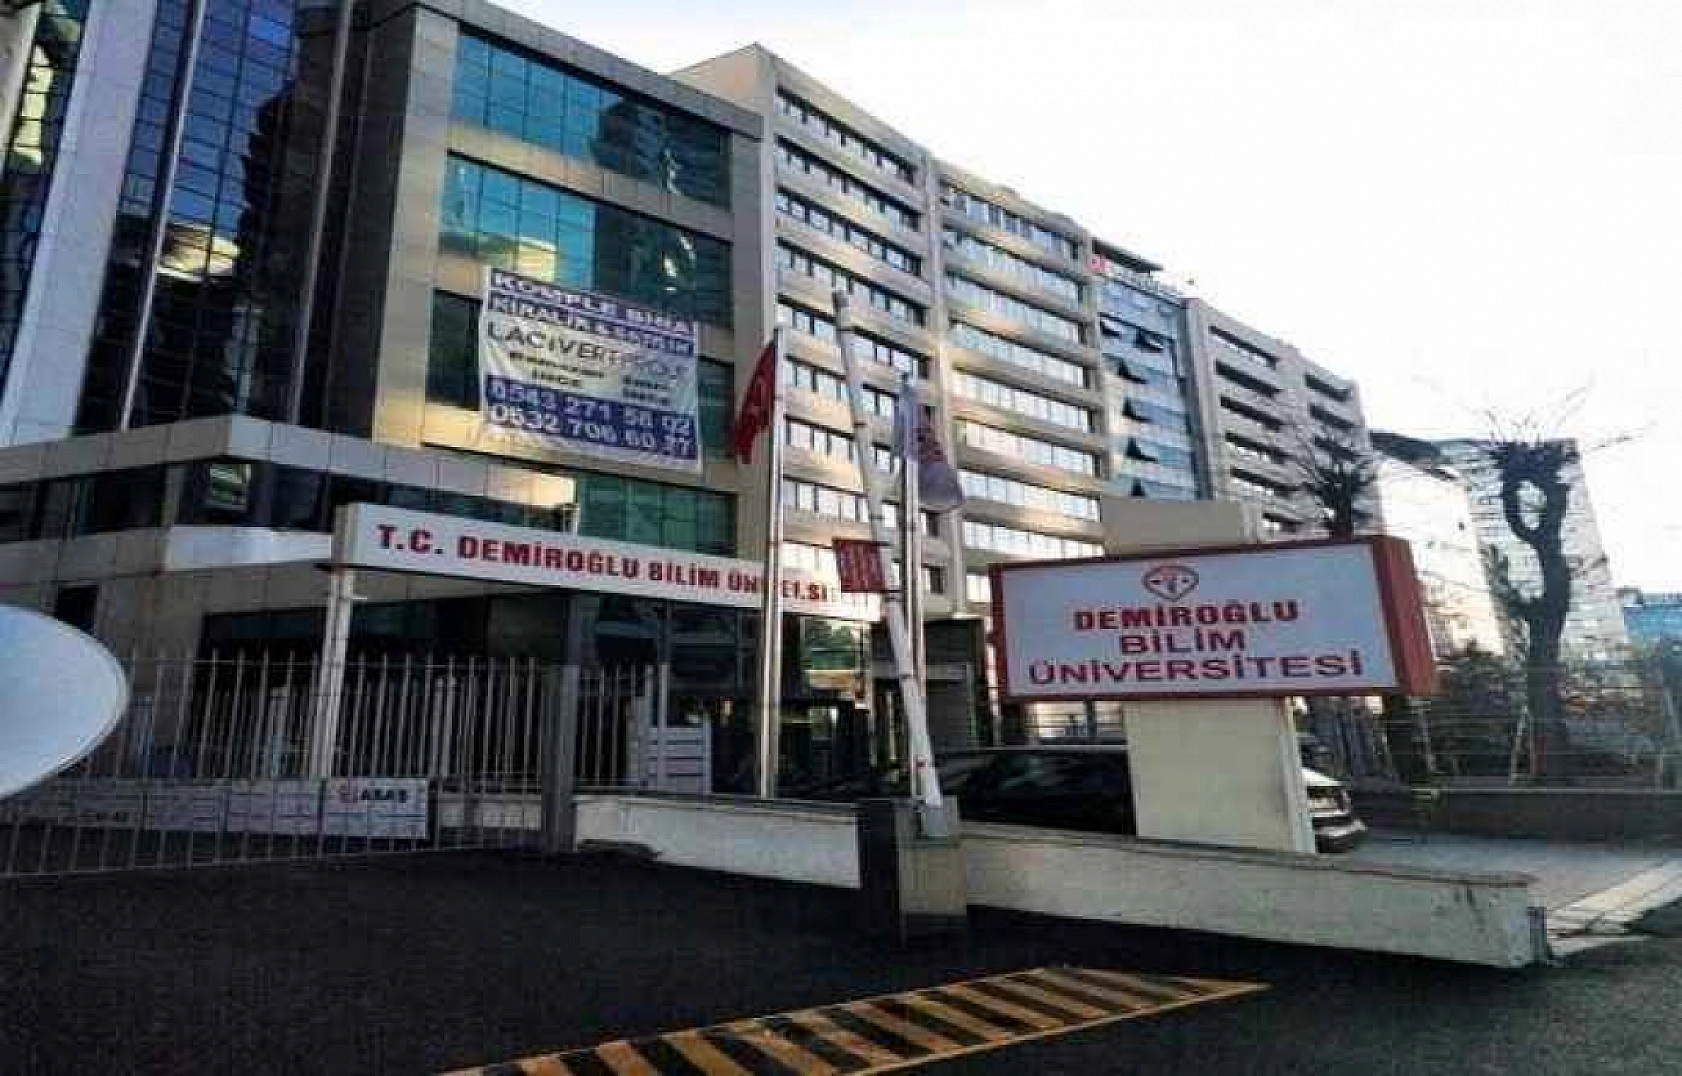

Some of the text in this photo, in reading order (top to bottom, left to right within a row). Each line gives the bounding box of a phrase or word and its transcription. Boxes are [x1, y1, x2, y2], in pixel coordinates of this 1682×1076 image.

[378, 524, 444, 556] T.C.
[457, 534, 639, 580] DEMİROĞLU
[648, 560, 720, 590] BİLİM
[1073, 598, 1300, 631] DEMİROĞLU
[1119, 628, 1246, 655] BİLİM
[1028, 650, 1363, 685] ÜNİVERSİTESİ
